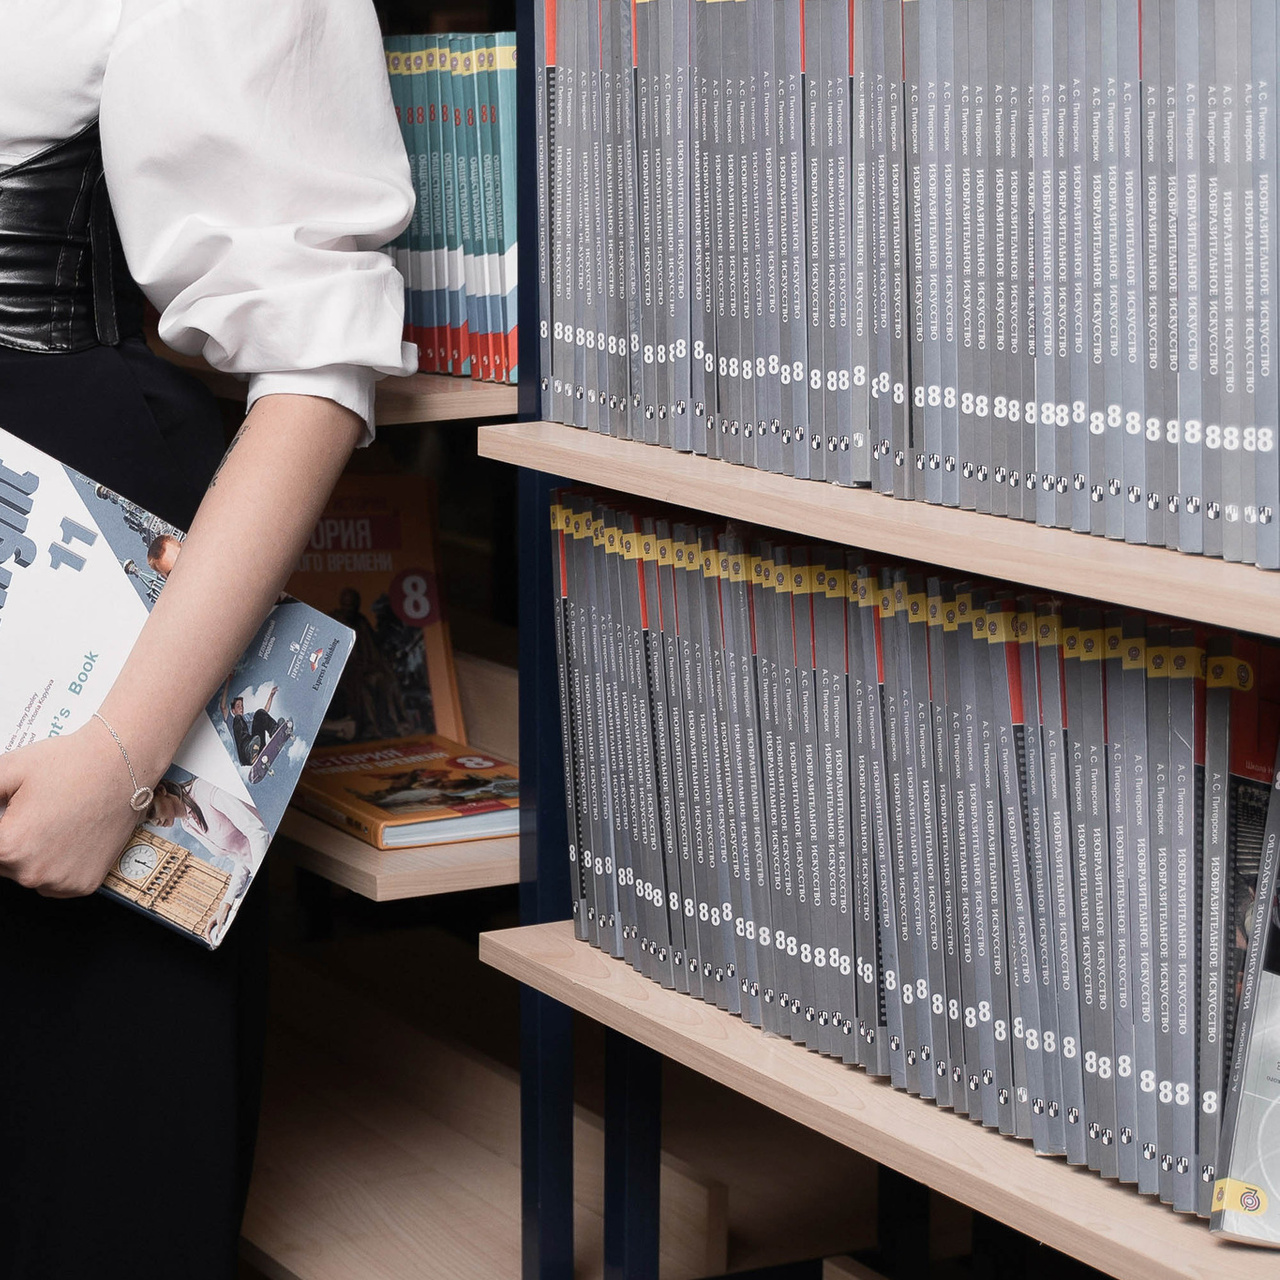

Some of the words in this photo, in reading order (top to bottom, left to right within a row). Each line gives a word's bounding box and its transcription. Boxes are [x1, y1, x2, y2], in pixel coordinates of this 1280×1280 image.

[1147, 111, 1156, 163] Питерских
[1257, 106, 1268, 160] Питерских
[1147, 175, 1157, 292] ИЗОБРАЗИТЕЛЬНОЕ
[1258, 173, 1269, 296] ИЗОБРАЗИТЕЛЬНОЕ
[675, 338, 686, 358] 8
[1147, 296, 1158, 369] ИСКУССТВО
[1259, 300, 1270, 377] ИСКУССТВО
[1146, 417, 1161, 442] 8
[1257, 427, 1273, 452] 8
[47, 516, 99, 573] 11
[310, 518, 373, 550] ОРИЯ
[327, 553, 394, 573] ВРЕМЕНИ
[401, 575, 431, 619] 8
[290, 625, 316, 679] ПРОСВЕЩЕНИЕ
[311, 667, 326, 692] Express
[321, 638, 340, 670] Publishing
[27, 704, 42, 726] Victoria
[38, 679, 55, 705] Kopylova
[48, 707, 71, 738] nt's
[67, 650, 99, 696] Book
[4, 734, 18, 751] Evans
[16, 712, 29, 730] Jenny
[24, 692, 39, 713] Dooley
[374, 751, 451, 769] ВРЕМЕНИ
[454, 755, 497, 769] 8
[834, 749, 846, 848] ИЗОБРАЗИТЕЛЬНОЕ
[1176, 786, 1186, 836] Питерских
[1211, 795, 1220, 845] Питерских
[838, 851, 847, 914] ИСКУССТВО
[1177, 847, 1187, 959] ИЗОБРАЗИТЕЛЬНОЕ
[1209, 856, 1220, 969] ИЗОБРАЗИТЕЛЬНОЕ
[839, 955, 851, 975] 8
[1235, 1021, 1247, 1069] Питерских
[1243, 902, 1265, 1010] ИЗОБРАЗИТЕЛЬНОЕ
[1259, 833, 1276, 900] ИСКУССТВО
[1177, 963, 1187, 1035] ИСКУССТВО
[1207, 971, 1218, 1043] ИСКУССТВО
[1175, 1082, 1190, 1106] 8
[1202, 1090, 1218, 1114] 8
